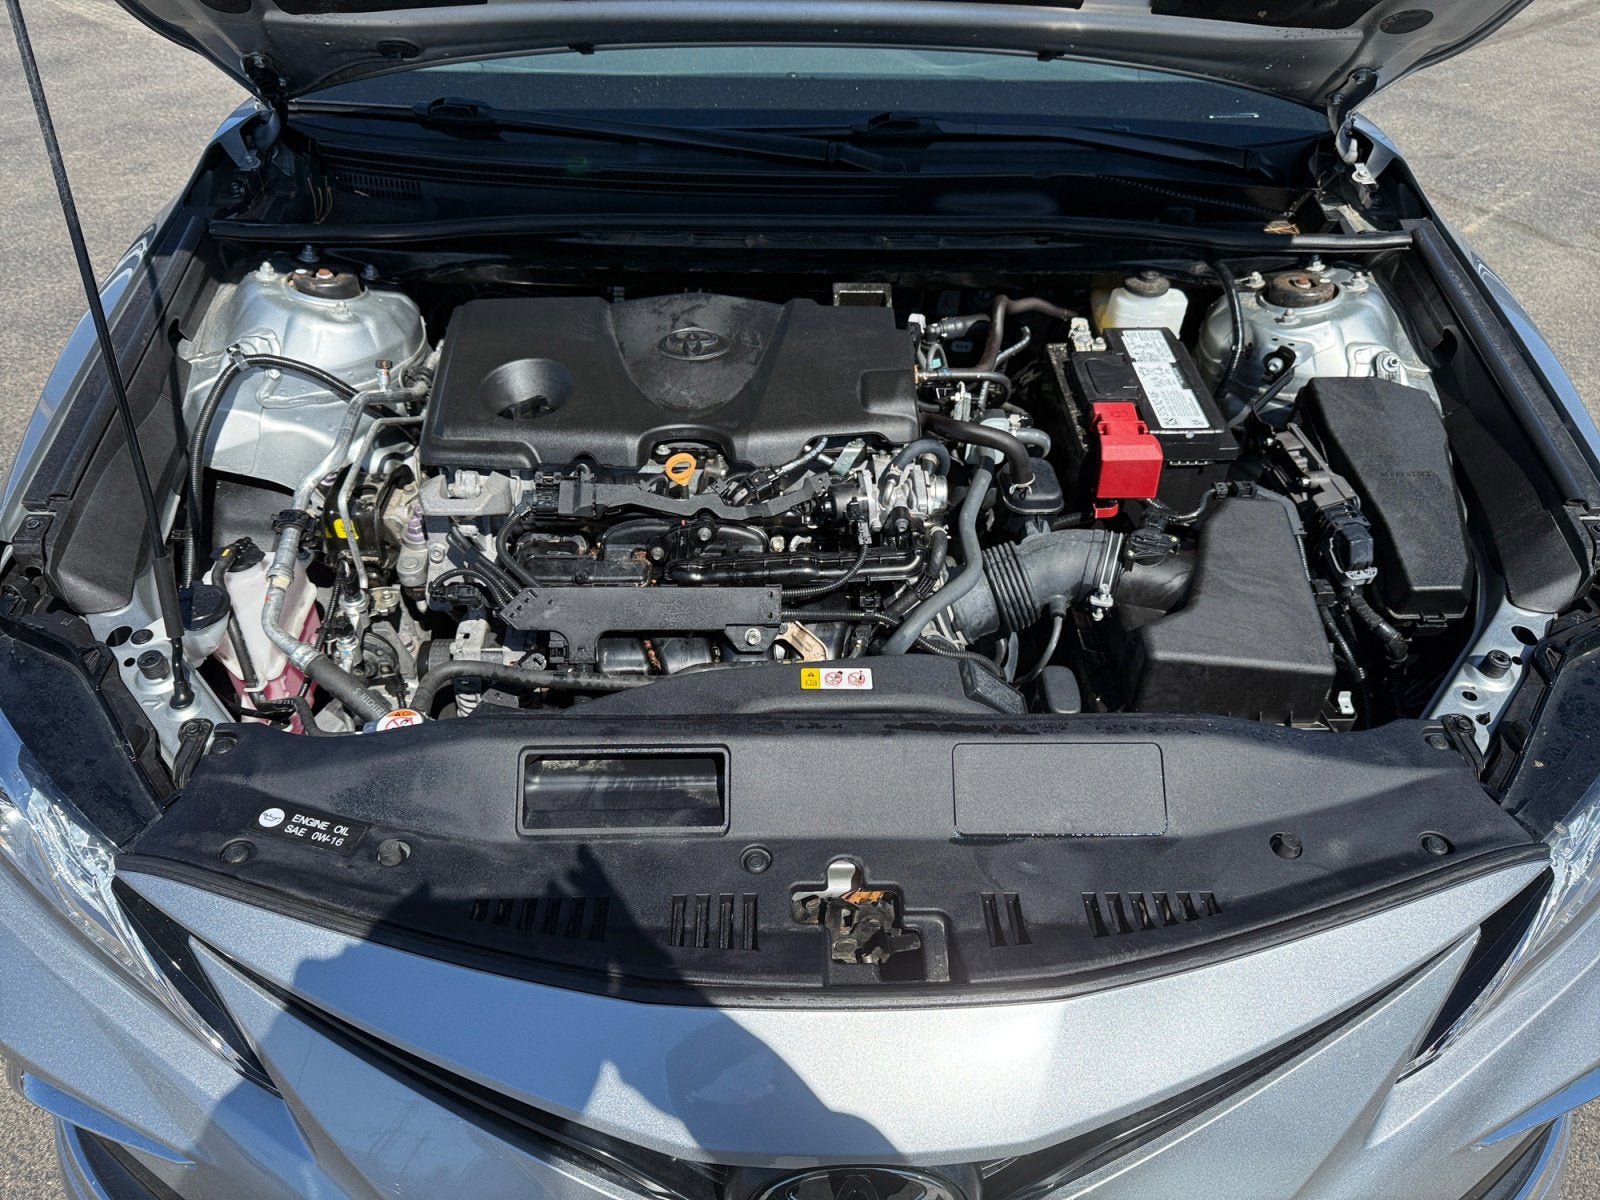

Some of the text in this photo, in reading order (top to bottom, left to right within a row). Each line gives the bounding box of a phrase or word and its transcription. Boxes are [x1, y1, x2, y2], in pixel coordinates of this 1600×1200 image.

[360, 692, 388, 718] NICHIRI
[284, 824, 345, 847] SAE 0W-16
[291, 814, 350, 836] ENGINE OIL
